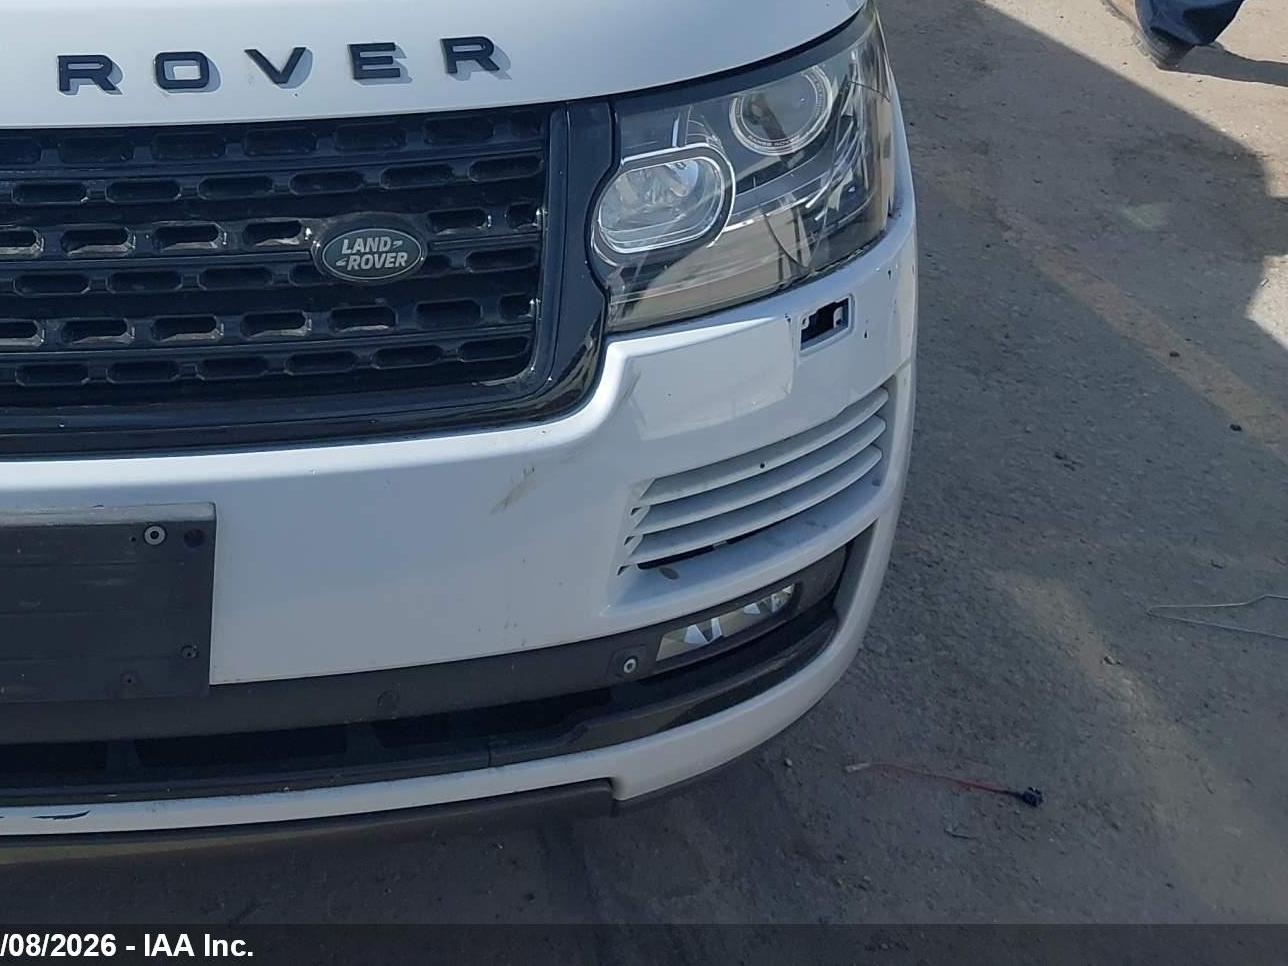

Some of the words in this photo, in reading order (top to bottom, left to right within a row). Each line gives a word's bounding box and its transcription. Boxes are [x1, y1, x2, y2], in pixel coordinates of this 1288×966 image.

[57, 35, 505, 92] ROVER
[341, 236, 392, 254] LAND
[347, 252, 408, 271] ROVER
